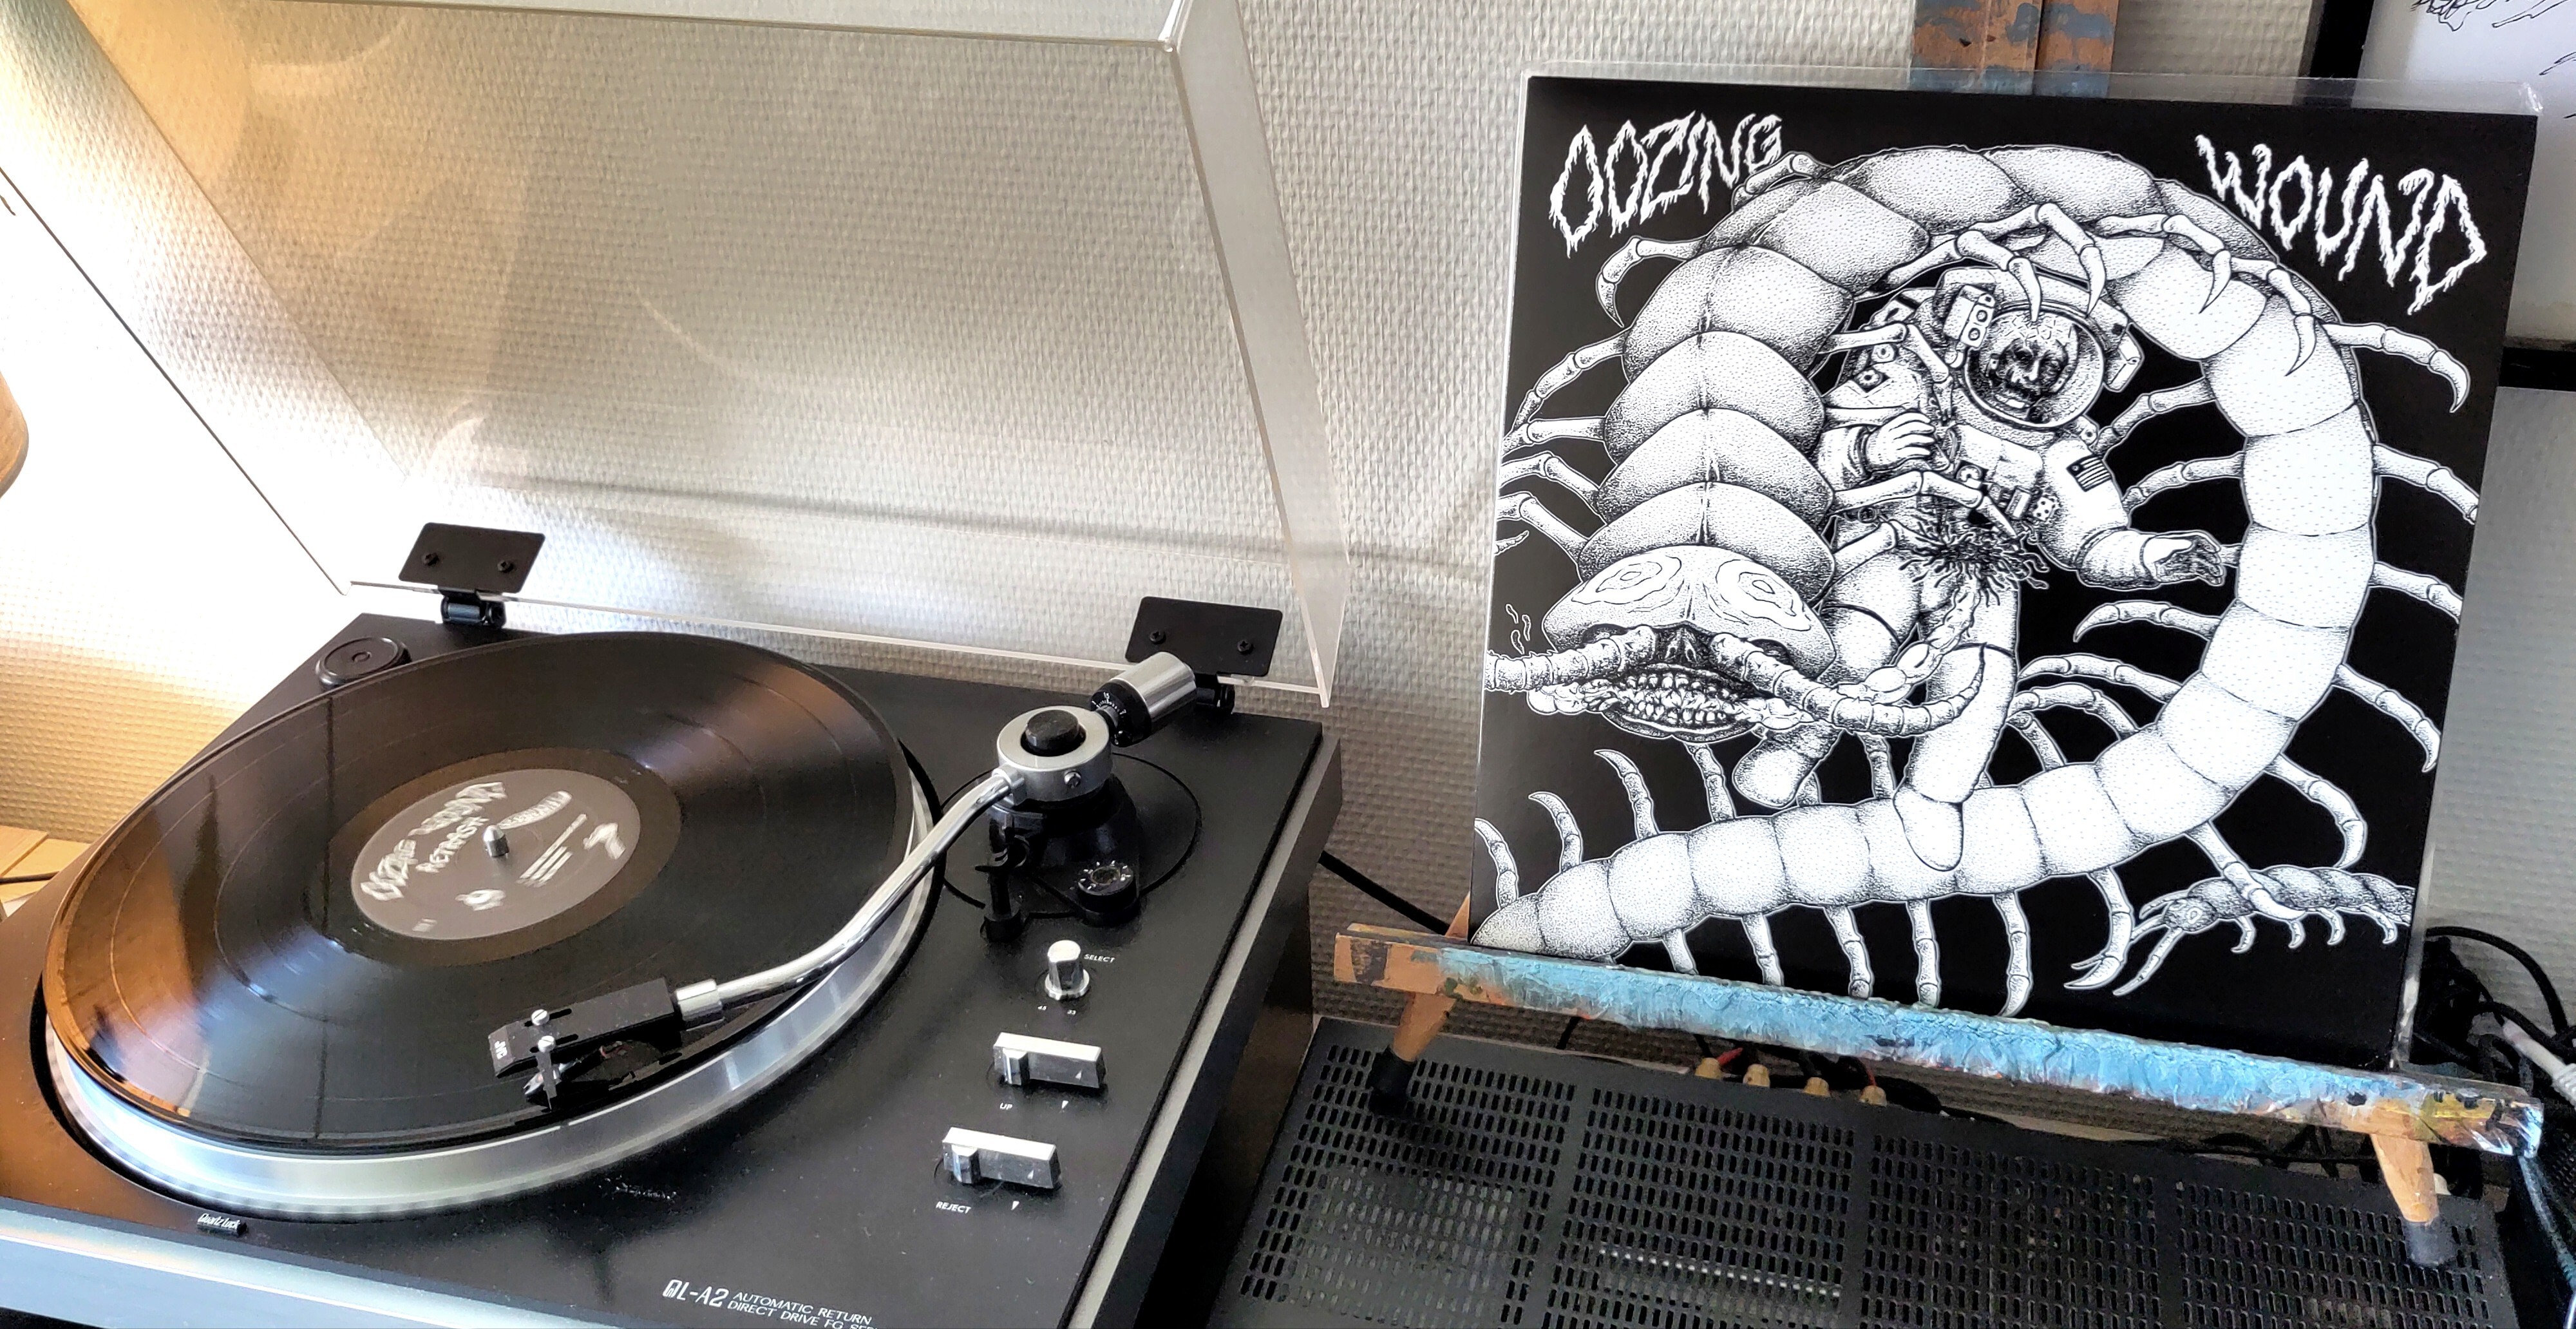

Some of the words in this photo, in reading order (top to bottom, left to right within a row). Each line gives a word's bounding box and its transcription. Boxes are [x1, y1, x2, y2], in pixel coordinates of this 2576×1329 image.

[1549, 110, 1783, 259] OOZING
[2195, 134, 2487, 315] WOUND
[1084, 953, 1115, 963] SELECT
[495, 1040, 507, 1059] JVC
[935, 1201, 971, 1214] REJECT
[662, 1279, 729, 1307] QL-A2
[727, 1300, 777, 1317] DIRECT
[781, 1310, 820, 1326] DRIVE
[824, 1319, 844, 1329] FG
[733, 1292, 813, 1314] AUTOMATIC
[818, 1307, 872, 1325] RETURN
